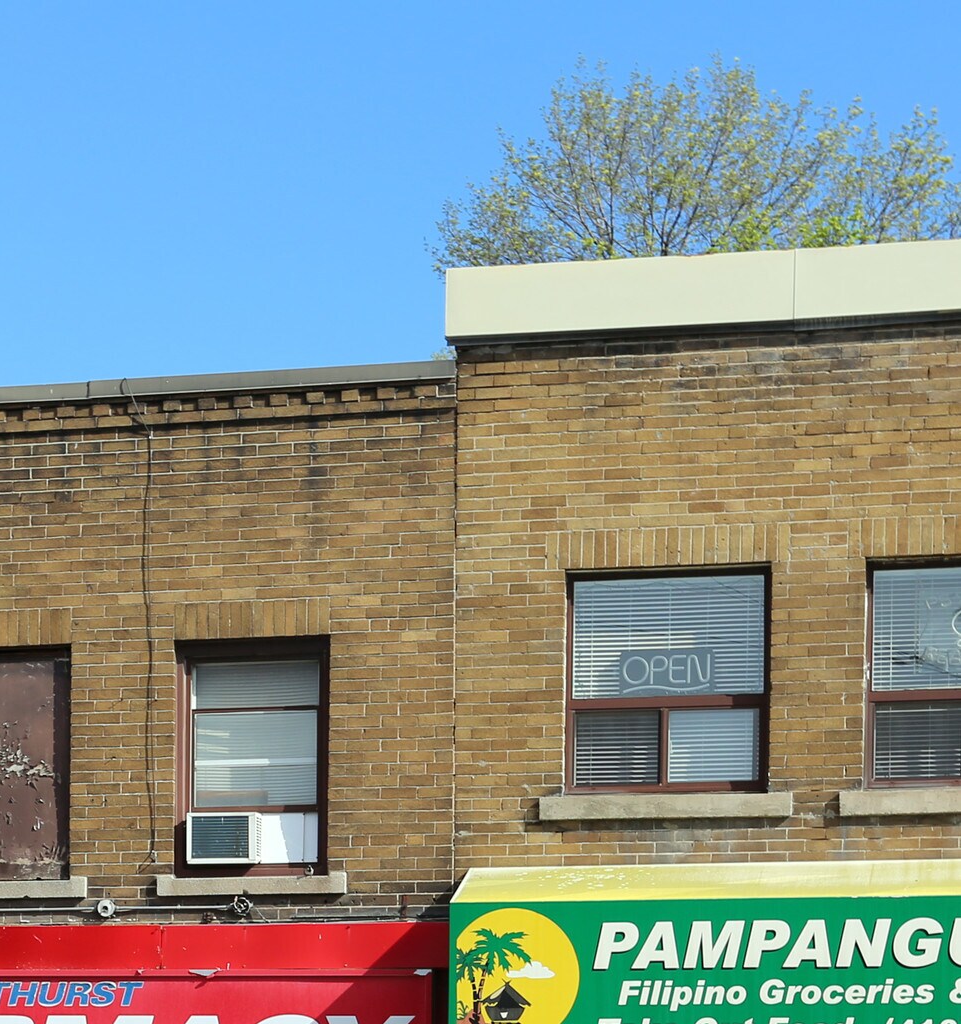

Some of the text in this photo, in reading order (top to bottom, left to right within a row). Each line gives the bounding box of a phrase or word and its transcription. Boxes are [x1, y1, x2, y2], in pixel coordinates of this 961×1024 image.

[623, 653, 711, 685] OPEN
[593, 917, 961, 970] PAMPANG
[618, 978, 748, 1011] Filipino
[759, 978, 935, 1006] Groceries
